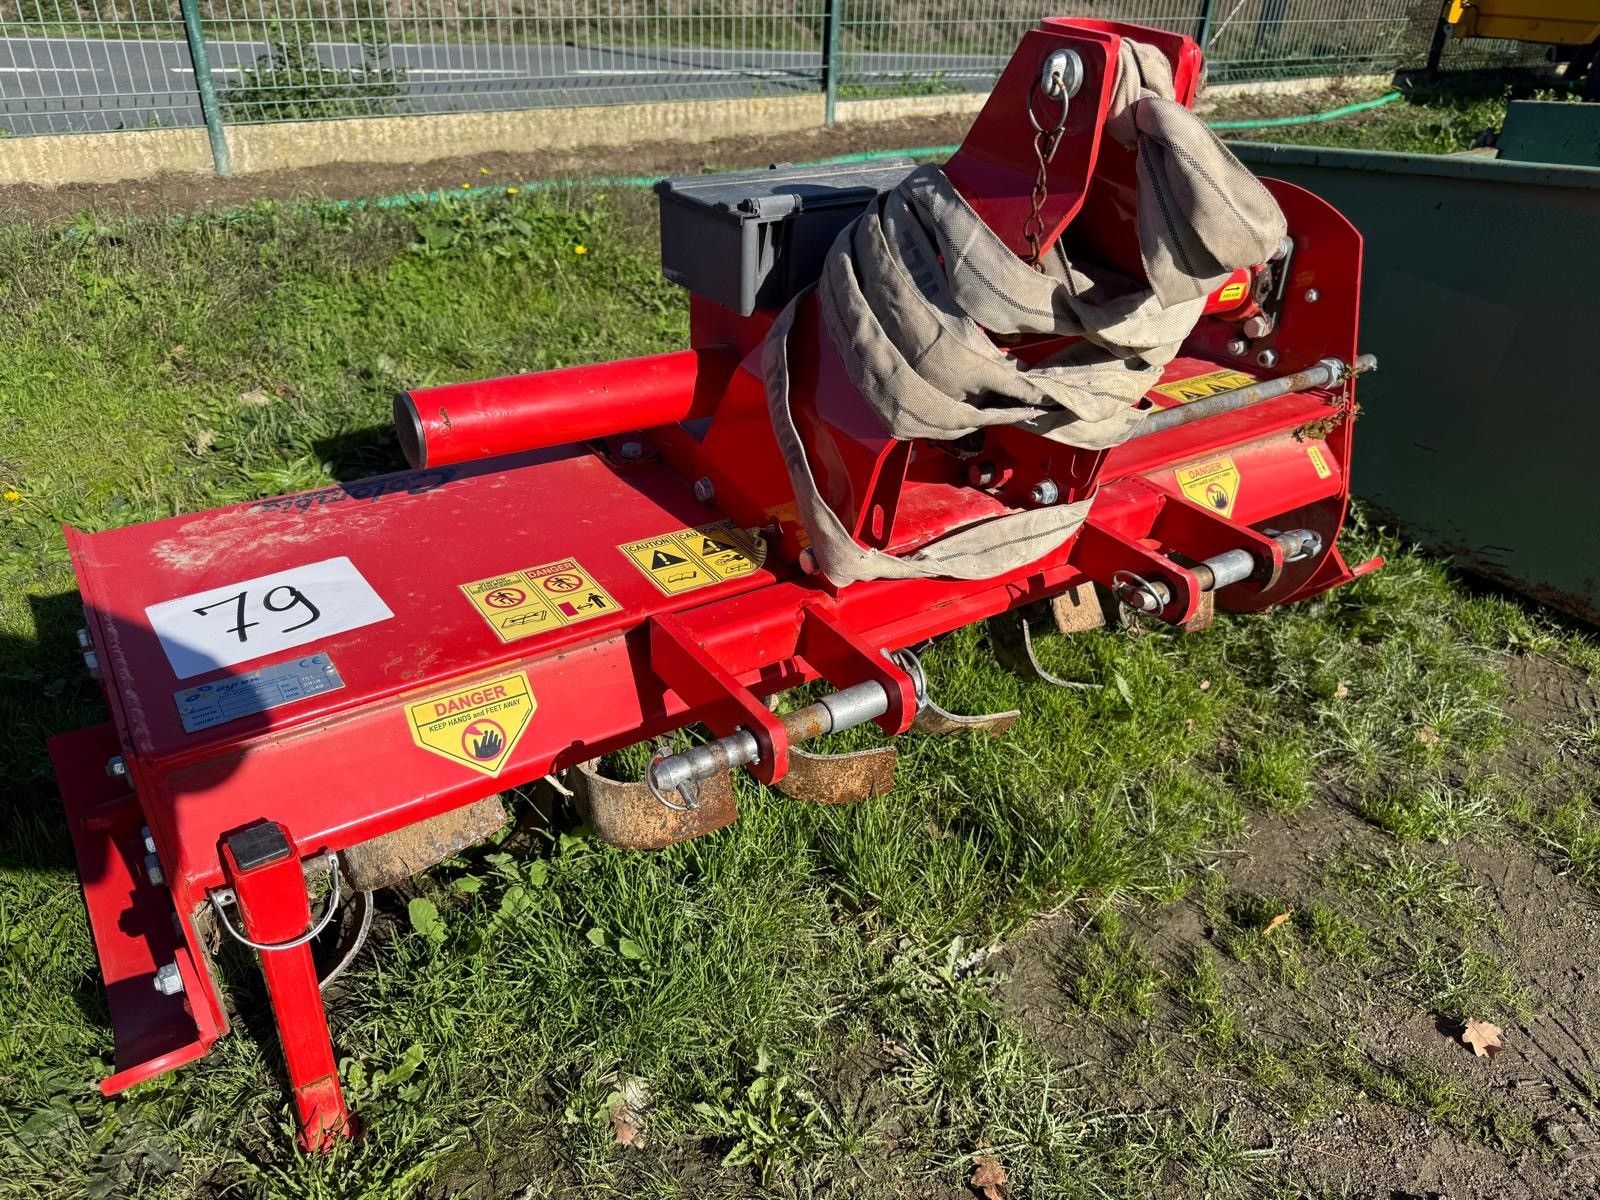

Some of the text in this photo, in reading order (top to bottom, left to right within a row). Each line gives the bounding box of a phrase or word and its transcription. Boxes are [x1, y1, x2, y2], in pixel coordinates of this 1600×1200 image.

[1188, 463, 1223, 480] DANGER
[678, 526, 718, 540] CAUTION
[629, 537, 670, 552] CAUTION
[527, 562, 574, 578] DANGER
[192, 585, 320, 642] 79
[434, 685, 507, 717] DANGER
[429, 698, 521, 733] KEEP HANDS and FEET AWAY
